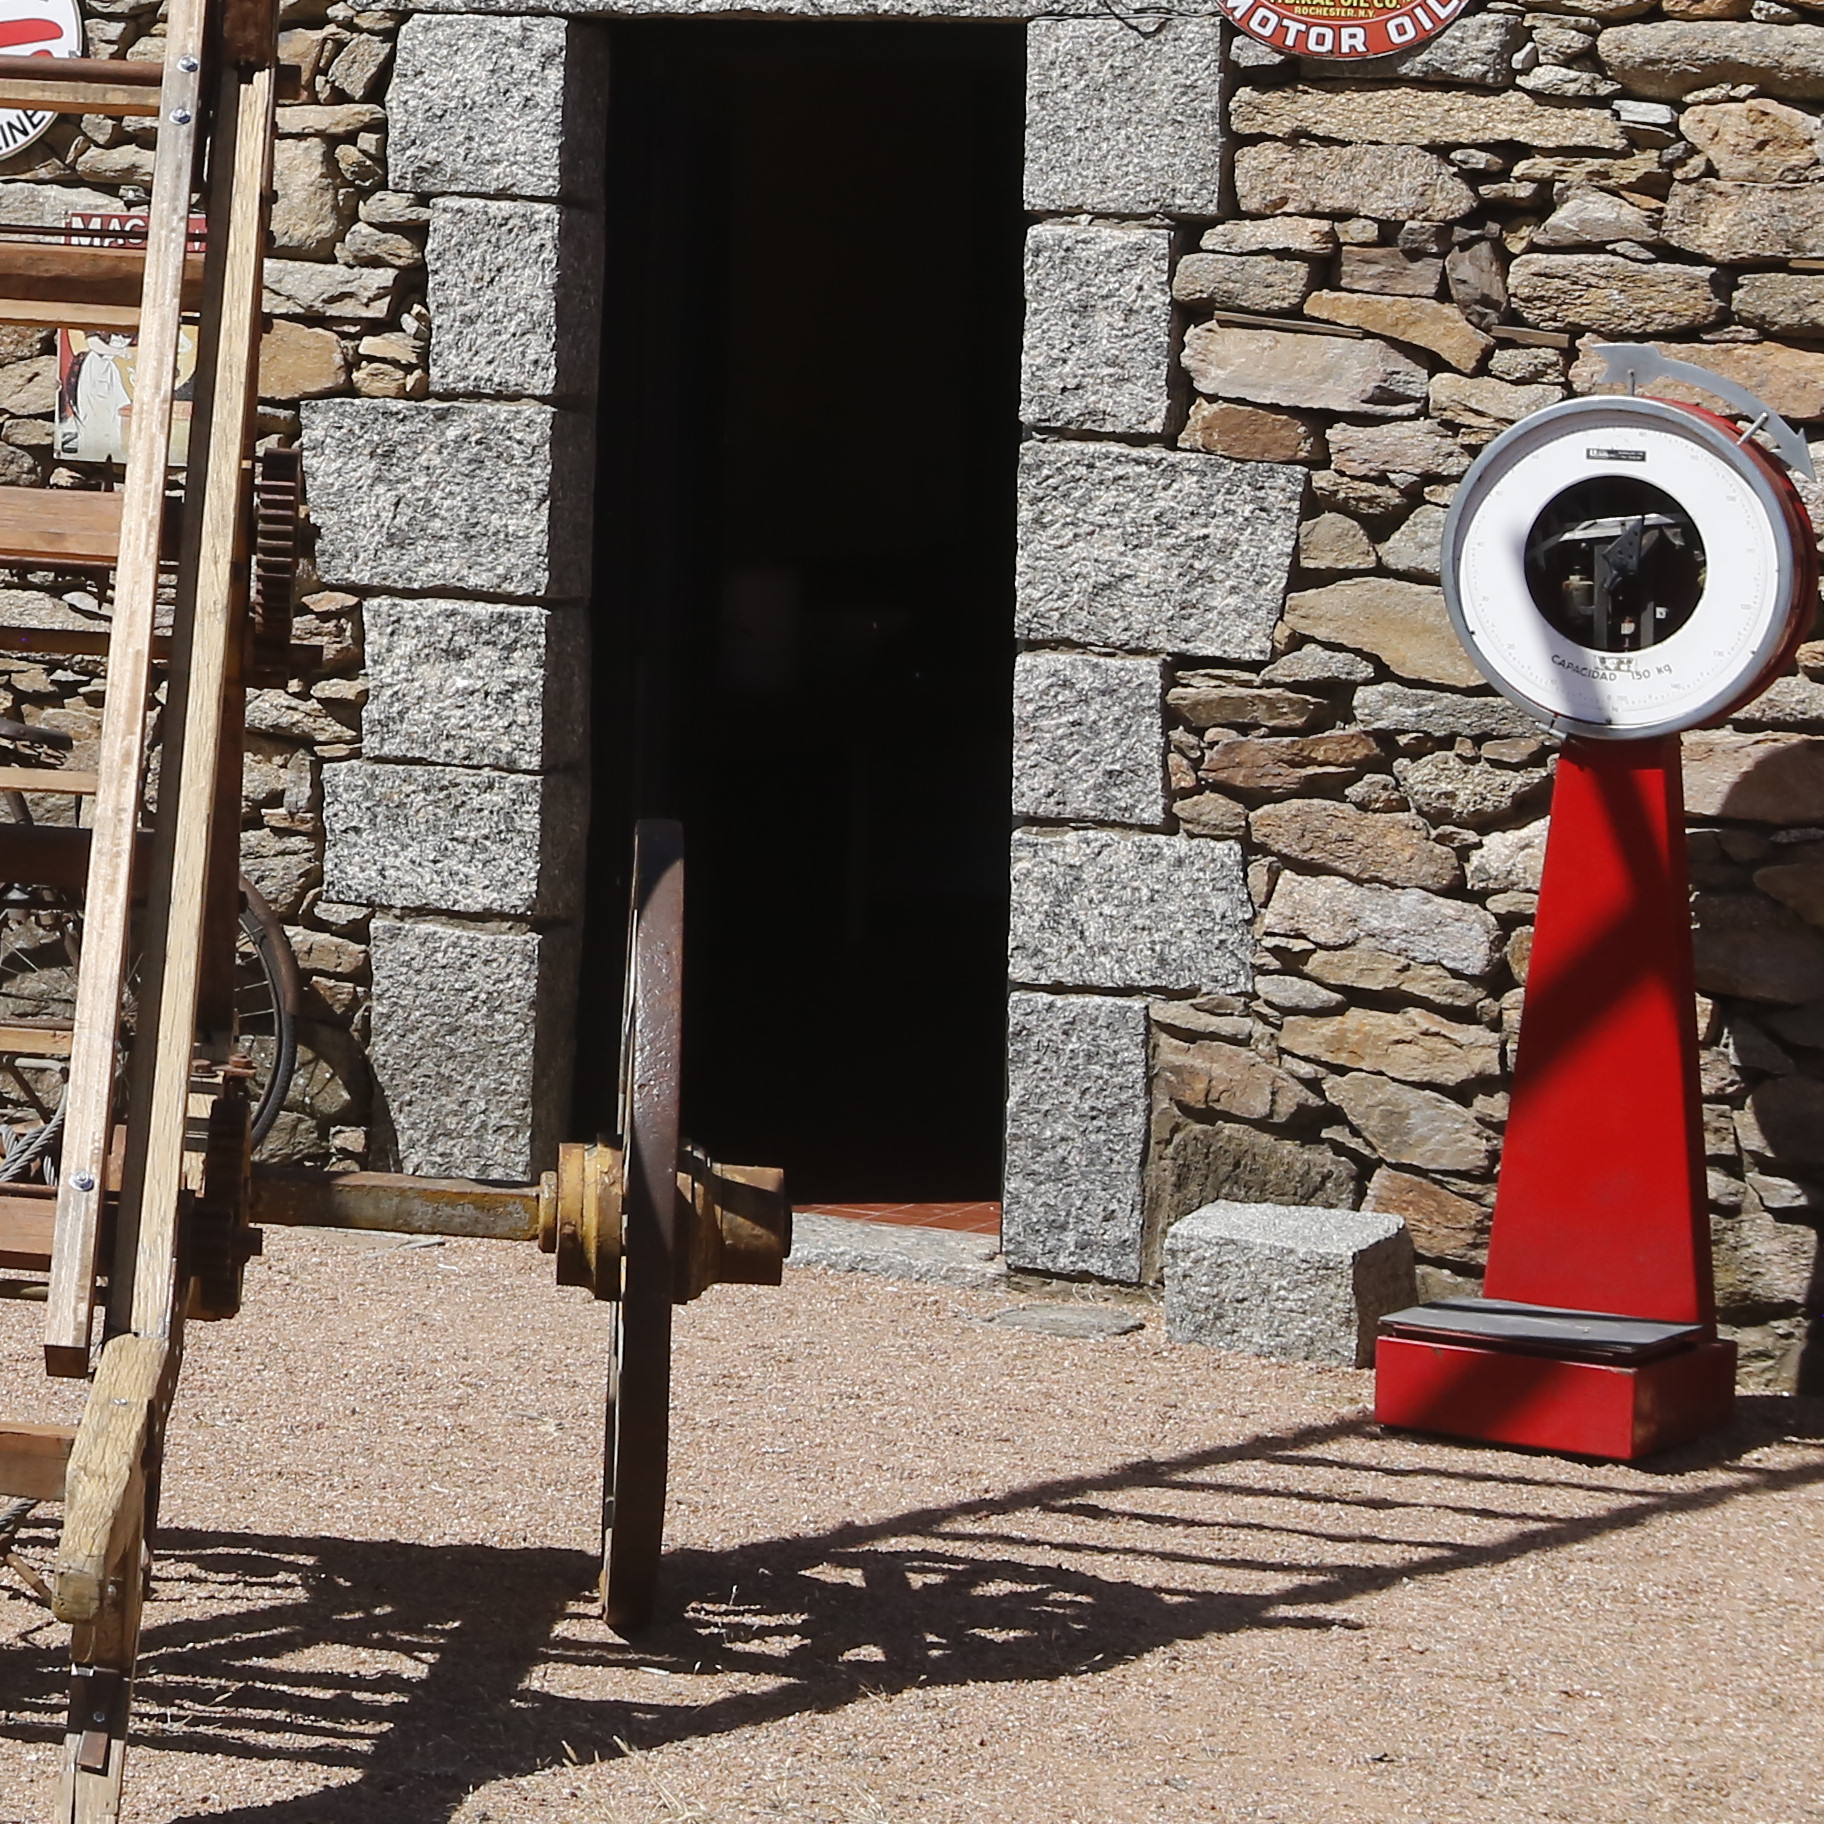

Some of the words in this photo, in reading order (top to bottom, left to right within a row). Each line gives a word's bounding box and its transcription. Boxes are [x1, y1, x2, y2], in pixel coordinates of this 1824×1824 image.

[1551, 654, 1617, 681] CAPACIDAD
[1631, 669, 1651, 680] 150
[1656, 663, 1673, 674] kg
